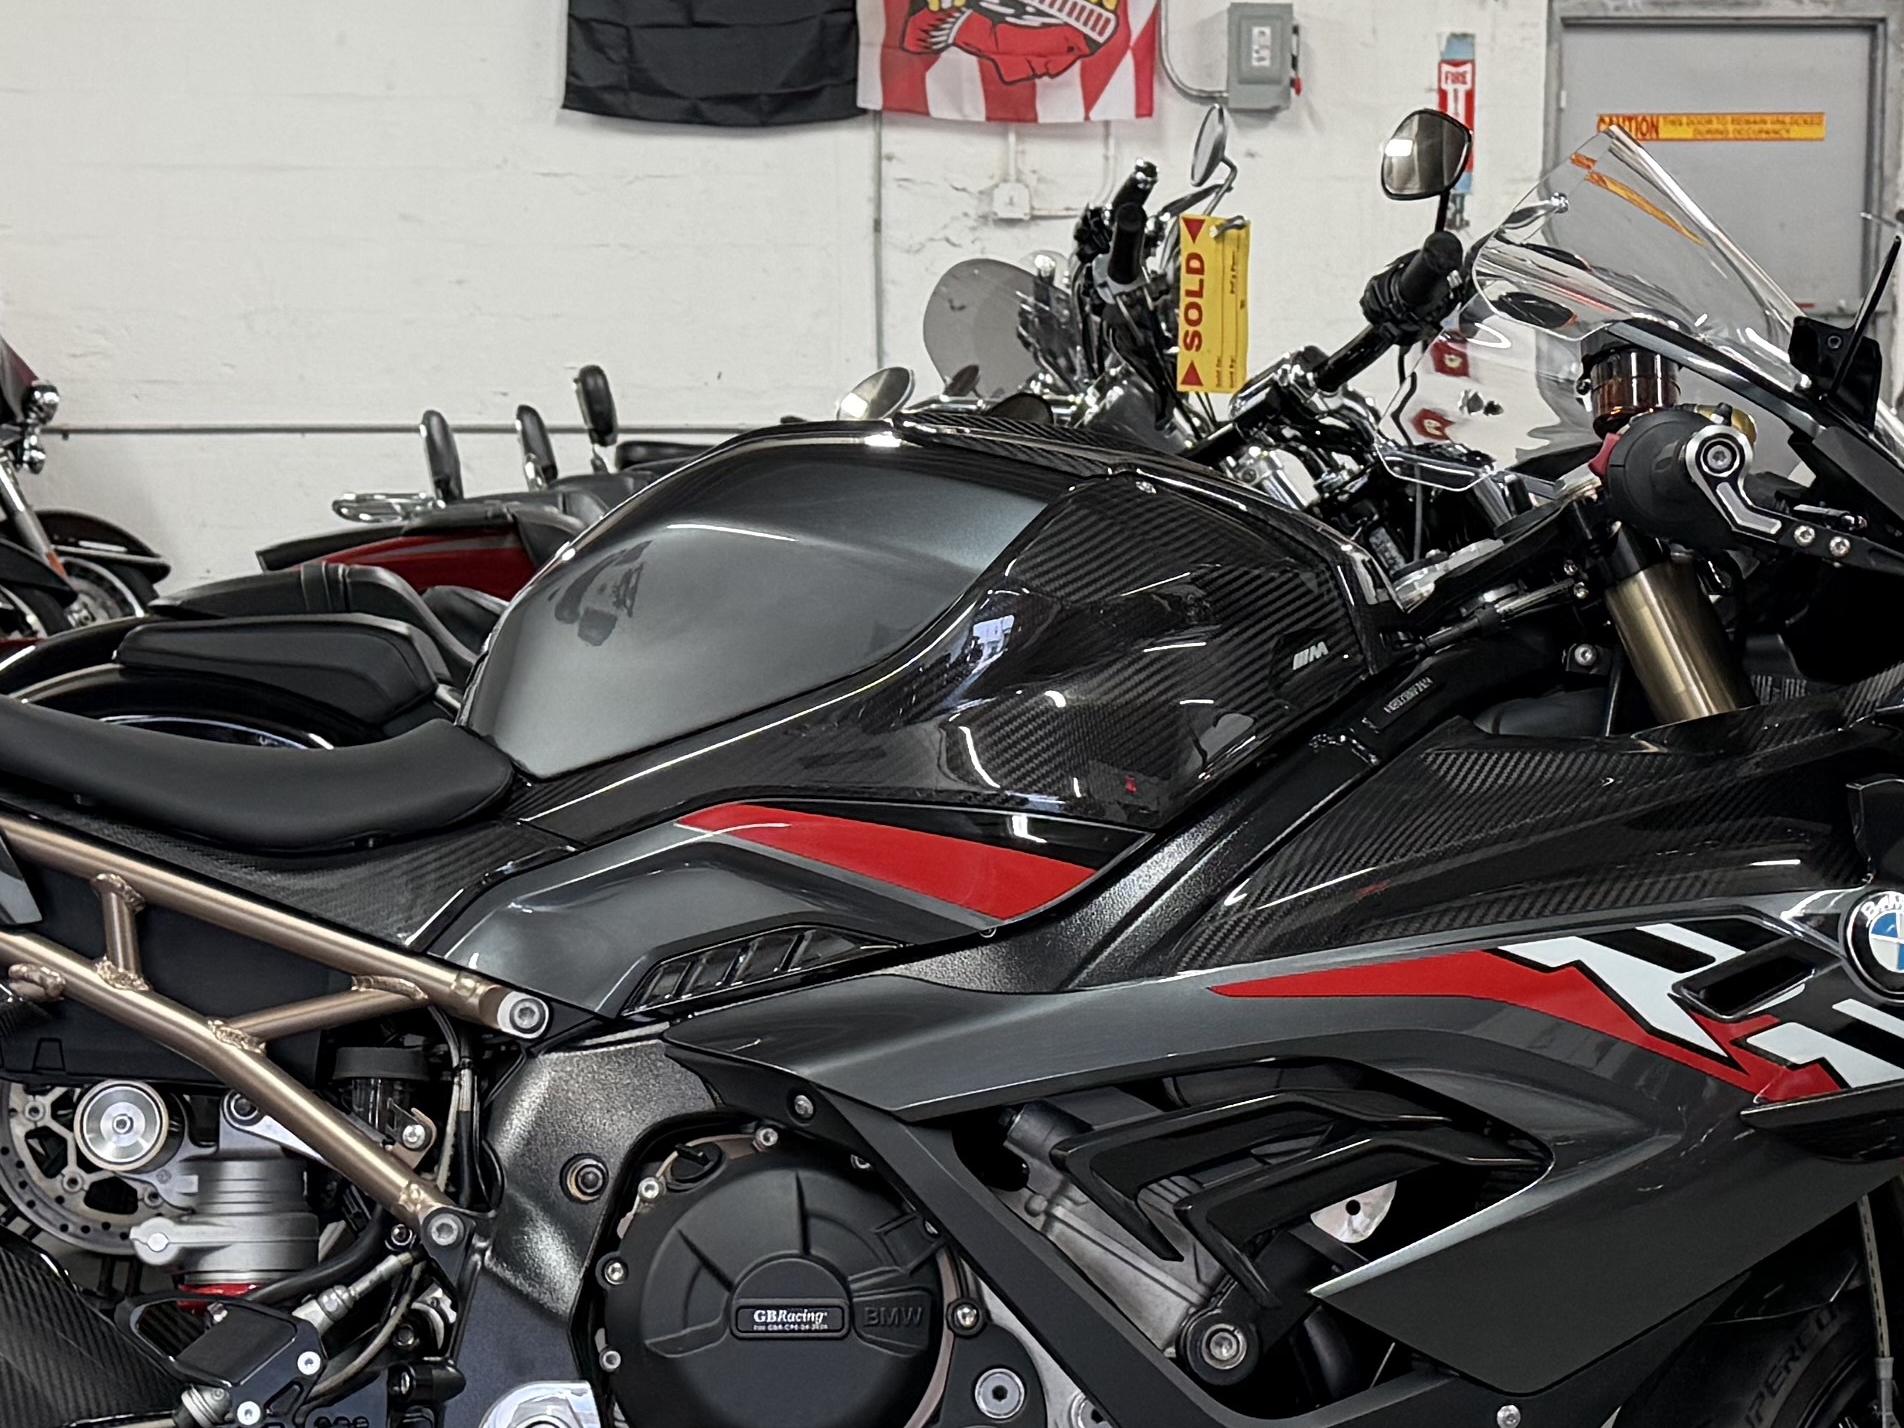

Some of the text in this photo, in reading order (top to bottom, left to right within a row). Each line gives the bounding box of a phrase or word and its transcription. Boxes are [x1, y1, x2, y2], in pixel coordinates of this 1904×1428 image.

[1445, 70, 1469, 85] FIRE
[1183, 252, 1205, 353] SOLD
[753, 1309, 828, 1324] GBRacing
[863, 1307, 924, 1328] BMW
